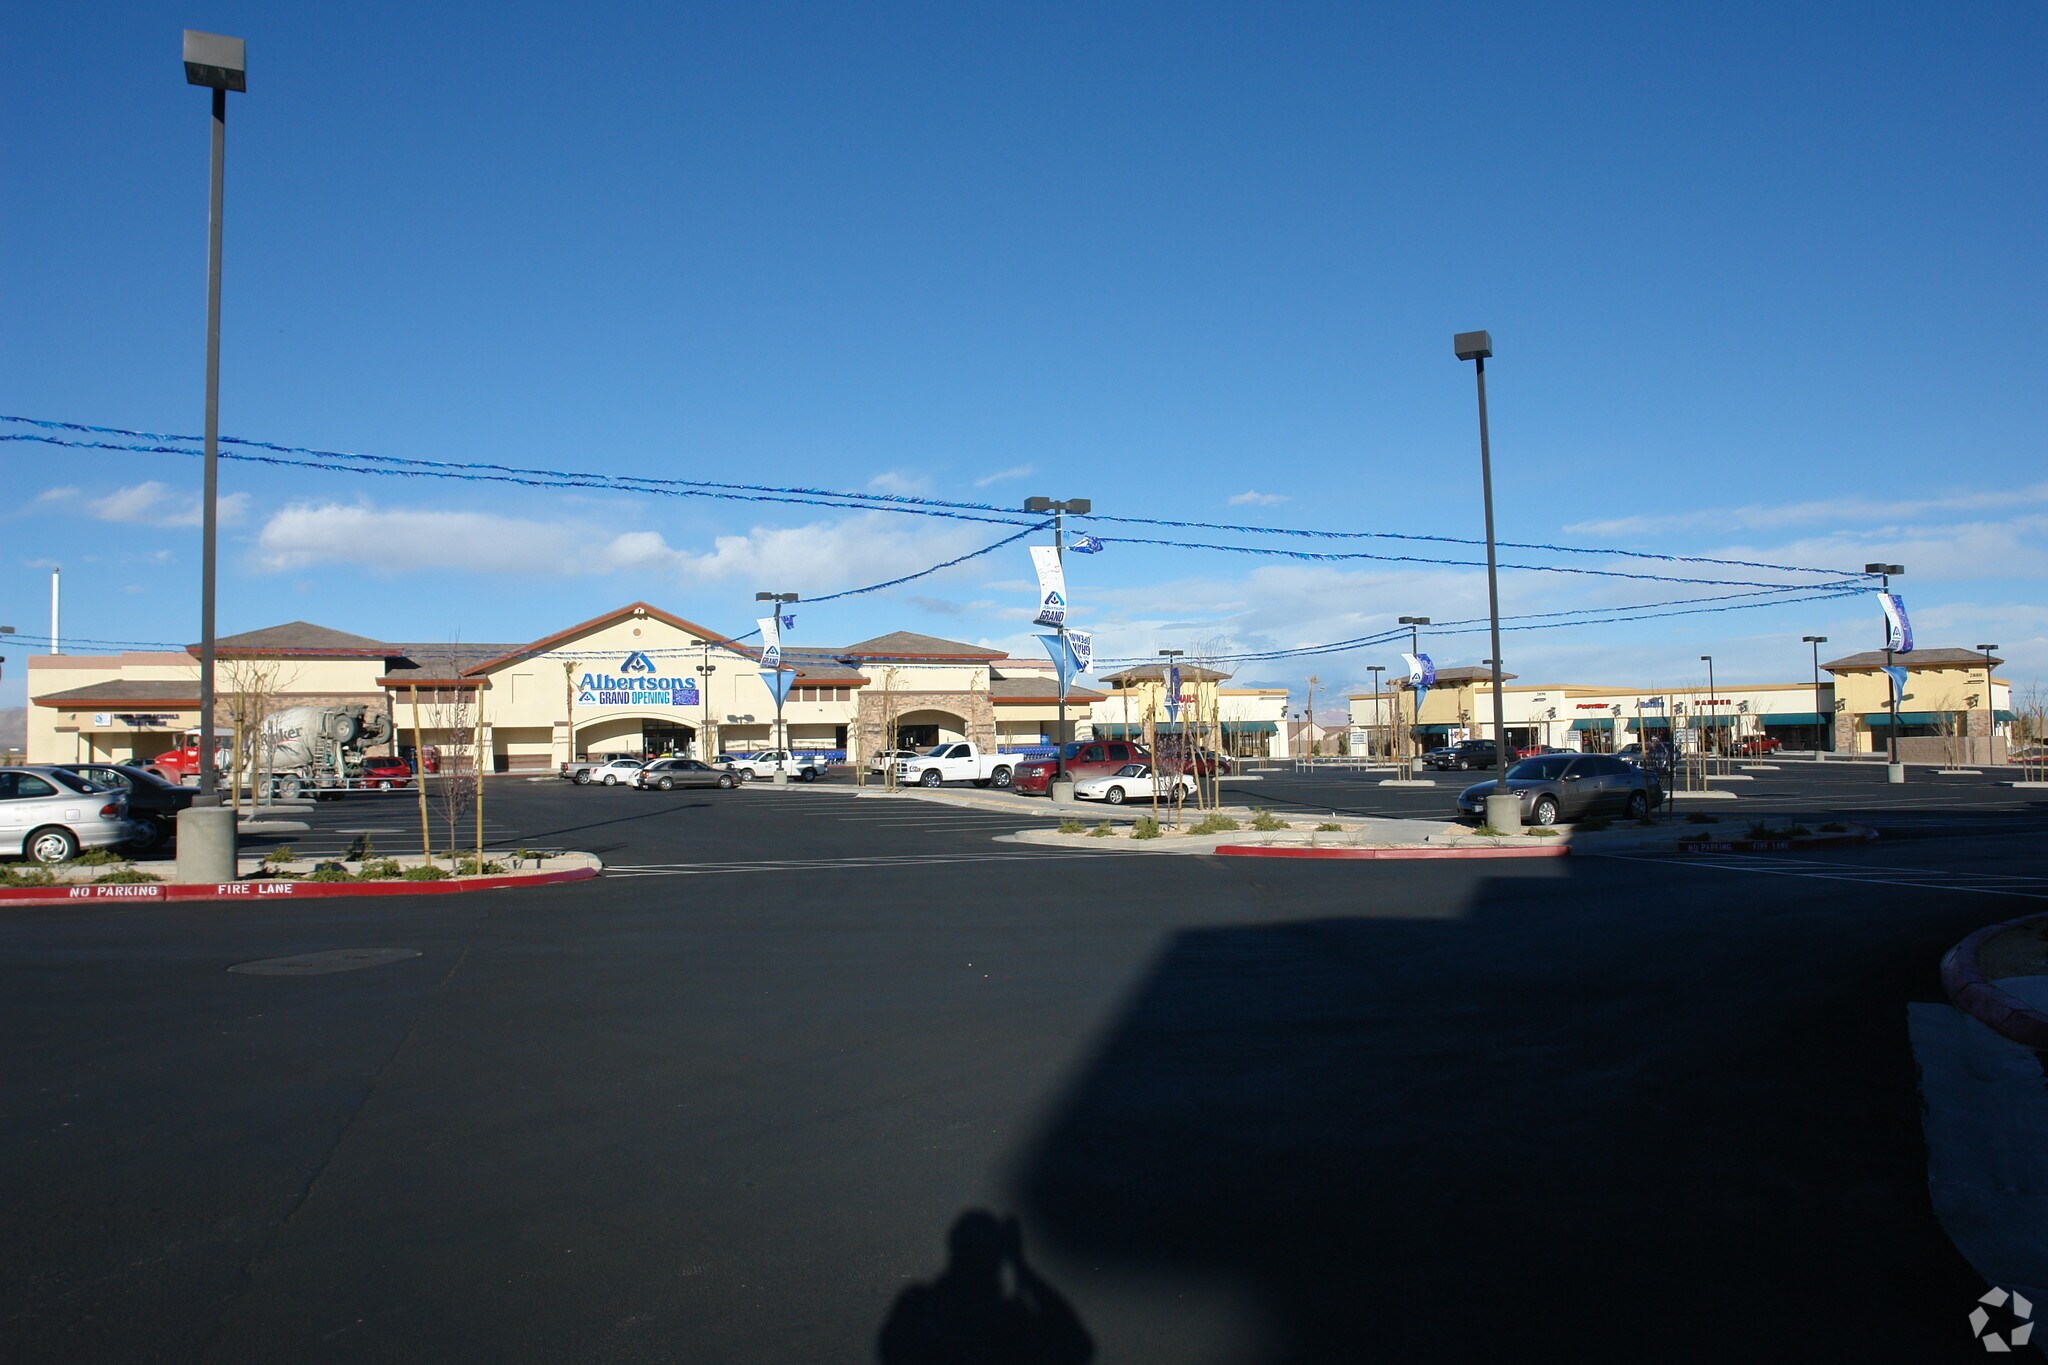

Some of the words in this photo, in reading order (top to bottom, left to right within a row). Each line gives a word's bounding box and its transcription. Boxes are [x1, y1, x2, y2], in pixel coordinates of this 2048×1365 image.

[1039, 610, 1064, 622] GRAND
[580, 673, 696, 690] Albertsons
[599, 691, 630, 705] GRAND
[631, 691, 671, 705] OPENING
[260, 727, 302, 747] Rker
[69, 887, 90, 898] NO
[97, 886, 158, 897] PARKING
[218, 884, 250, 895] FIRE
[258, 884, 293, 895] LANE
